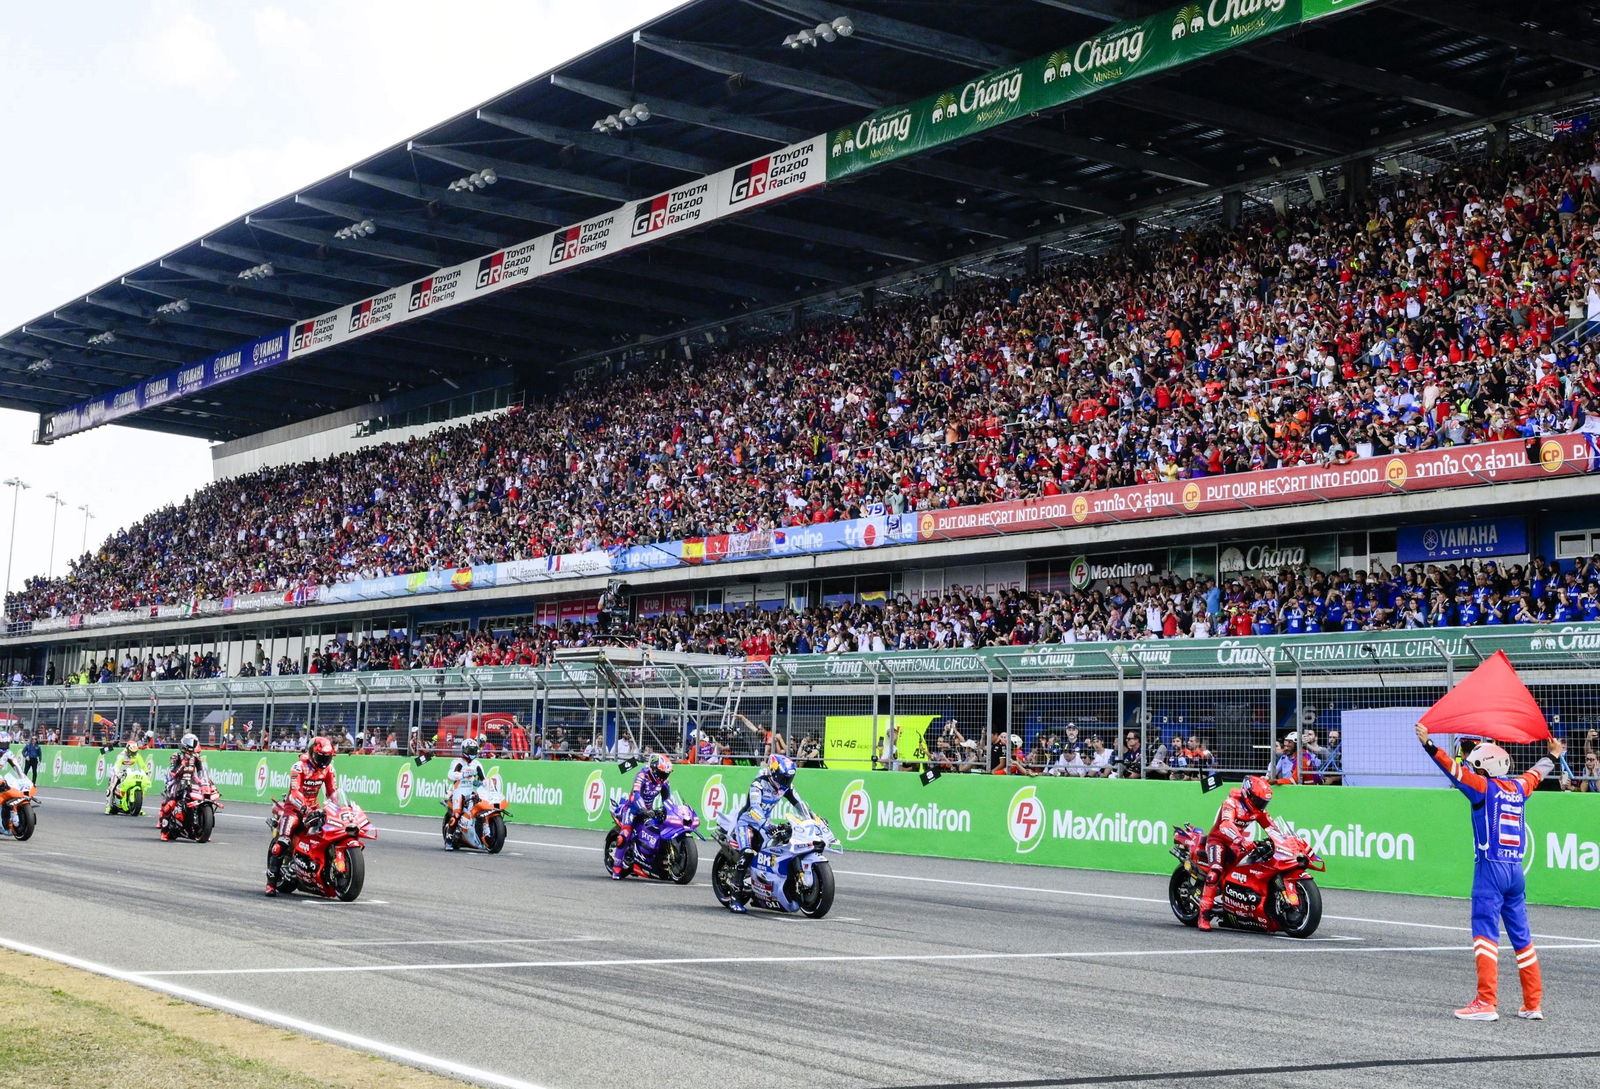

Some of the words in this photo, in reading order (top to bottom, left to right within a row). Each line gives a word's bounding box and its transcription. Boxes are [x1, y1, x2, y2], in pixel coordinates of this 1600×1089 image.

[1073, 31, 1145, 73] Chang
[960, 73, 1023, 114] Chang
[856, 114, 911, 149] Chang
[773, 143, 814, 166] TOYOTA
[770, 158, 808, 178] GAZOO
[731, 173, 768, 203] GR
[768, 171, 806, 190] Racing
[671, 183, 708, 202] TOYOTA
[669, 197, 703, 214] GAZOO
[582, 216, 614, 234] TOYOTA
[633, 209, 666, 235] GR
[667, 208, 701, 226] Racing
[580, 229, 610, 244] GAZOO
[506, 244, 535, 259] TOYOTA
[551, 240, 577, 263] GR
[579, 240, 607, 256] Racing
[502, 266, 529, 280] Racing
[504, 256, 531, 270] GAZOO
[434, 270, 461, 284] TOYOTA
[477, 265, 501, 288] GR
[431, 290, 456, 305] Racing
[432, 281, 457, 295] GAZOO
[373, 293, 397, 307] TOYOTA
[409, 290, 431, 310] GR
[315, 314, 338, 328] TOYOTA
[350, 312, 371, 332] GR
[370, 312, 391, 326] Racing
[259, 336, 283, 359] YAMAHA
[293, 330, 313, 351] GR
[219, 352, 241, 373] YAMAHA
[1543, 450, 1560, 462] CP
[1389, 467, 1403, 478] CP
[1207, 485, 1229, 500] PUT
[1232, 482, 1257, 497] OUR
[1310, 473, 1340, 489] INTO
[1343, 468, 1378, 485] FOOD
[1185, 491, 1198, 502] CP
[939, 516, 957, 530] PUT
[957, 513, 976, 527] OUR
[1016, 507, 1037, 522] INTO
[1040, 504, 1067, 519] FOOD
[1074, 504, 1086, 514] CP
[922, 520, 933, 531] CP
[1439, 524, 1498, 548] YAMAHA
[1428, 547, 1494, 557] RACING
[1091, 562, 1153, 580] Maxnitron
[671, 597, 687, 609] true
[1217, 640, 1275, 668] Chang
[1405, 635, 1474, 657] CIRCUIT
[825, 655, 862, 678] Chang
[339, 774, 381, 794] Maxnitron
[506, 782, 563, 806] Maxnitron
[589, 782, 601, 809] PT
[707, 788, 722, 818] PT
[848, 794, 865, 827] PT
[877, 800, 971, 833] Maxnitron
[1017, 801, 1038, 839] PT
[1053, 809, 1167, 845] Maxnitron
[1546, 832, 1600, 871] Ma
